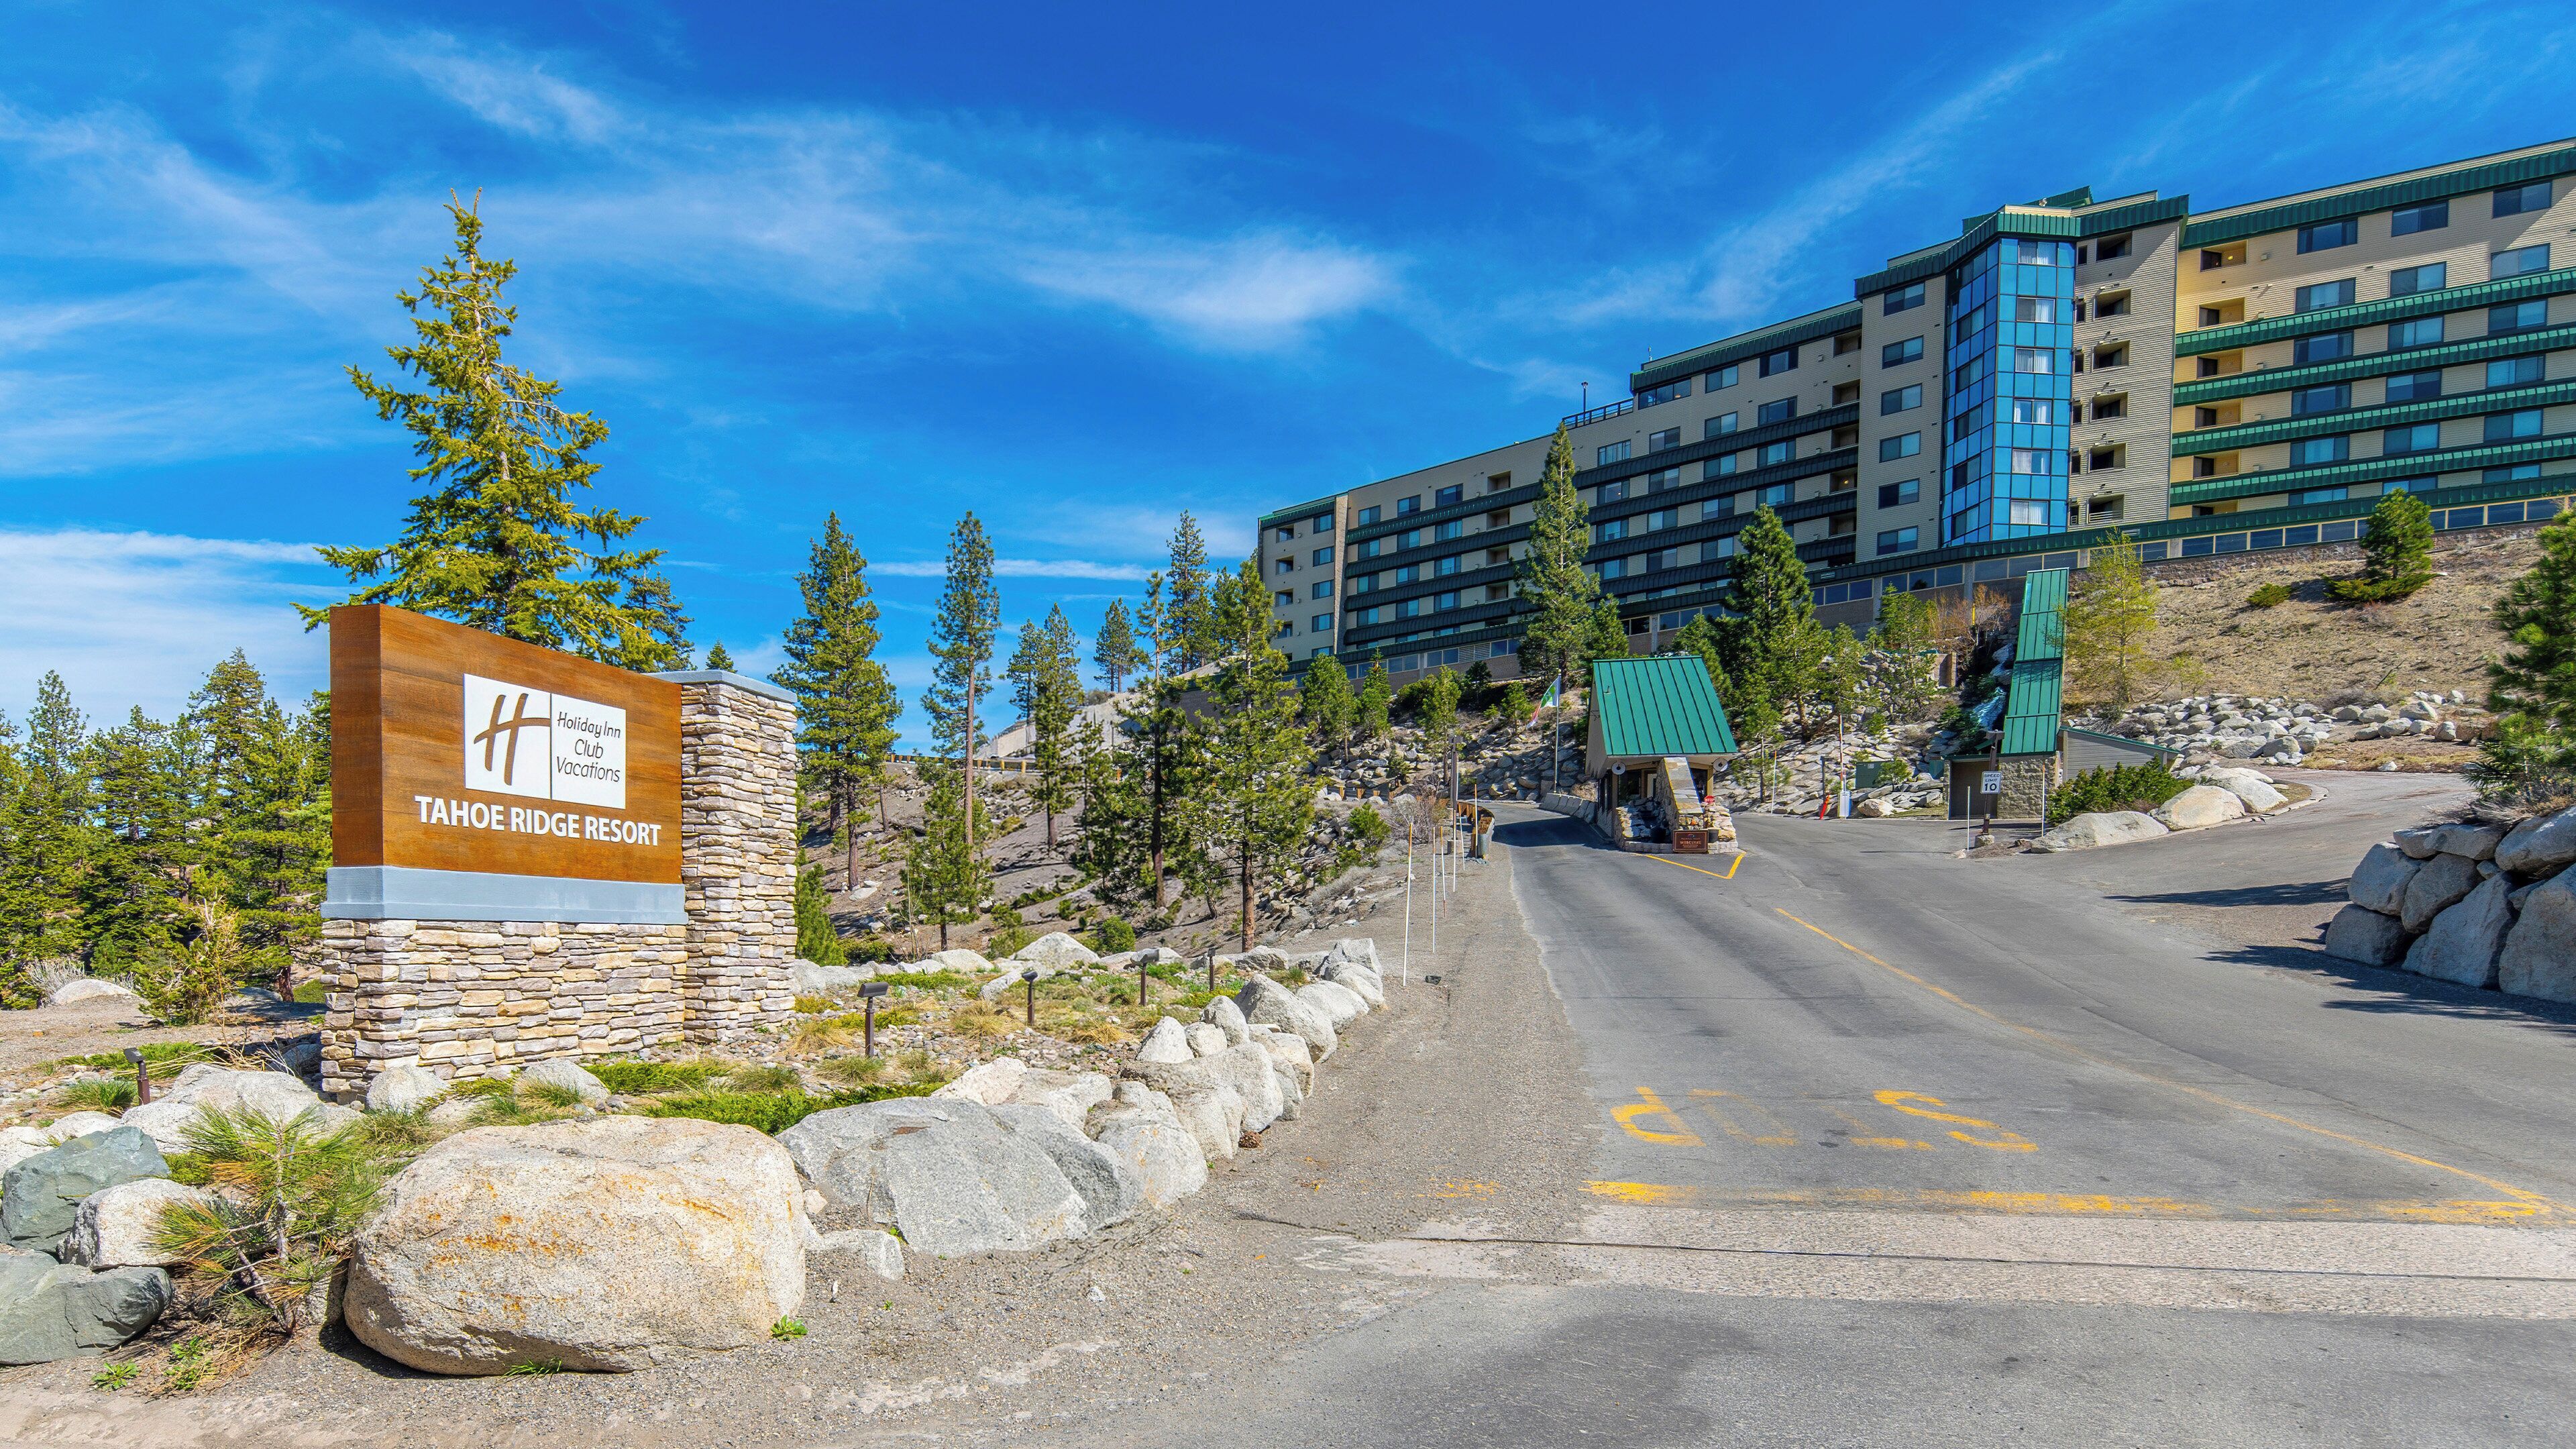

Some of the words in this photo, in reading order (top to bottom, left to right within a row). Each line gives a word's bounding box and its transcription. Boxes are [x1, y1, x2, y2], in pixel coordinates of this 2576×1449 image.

[557, 711, 602, 738] Holiday
[603, 721, 621, 739] Inn
[575, 739, 603, 759] Club
[557, 756, 621, 782] Vacations
[1984, 783, 1998, 791] 10
[415, 795, 504, 831] TAHOE
[511, 807, 580, 839] RIDGE
[585, 816, 661, 846] RESORT
[1611, 1086, 2039, 1152] STOP
